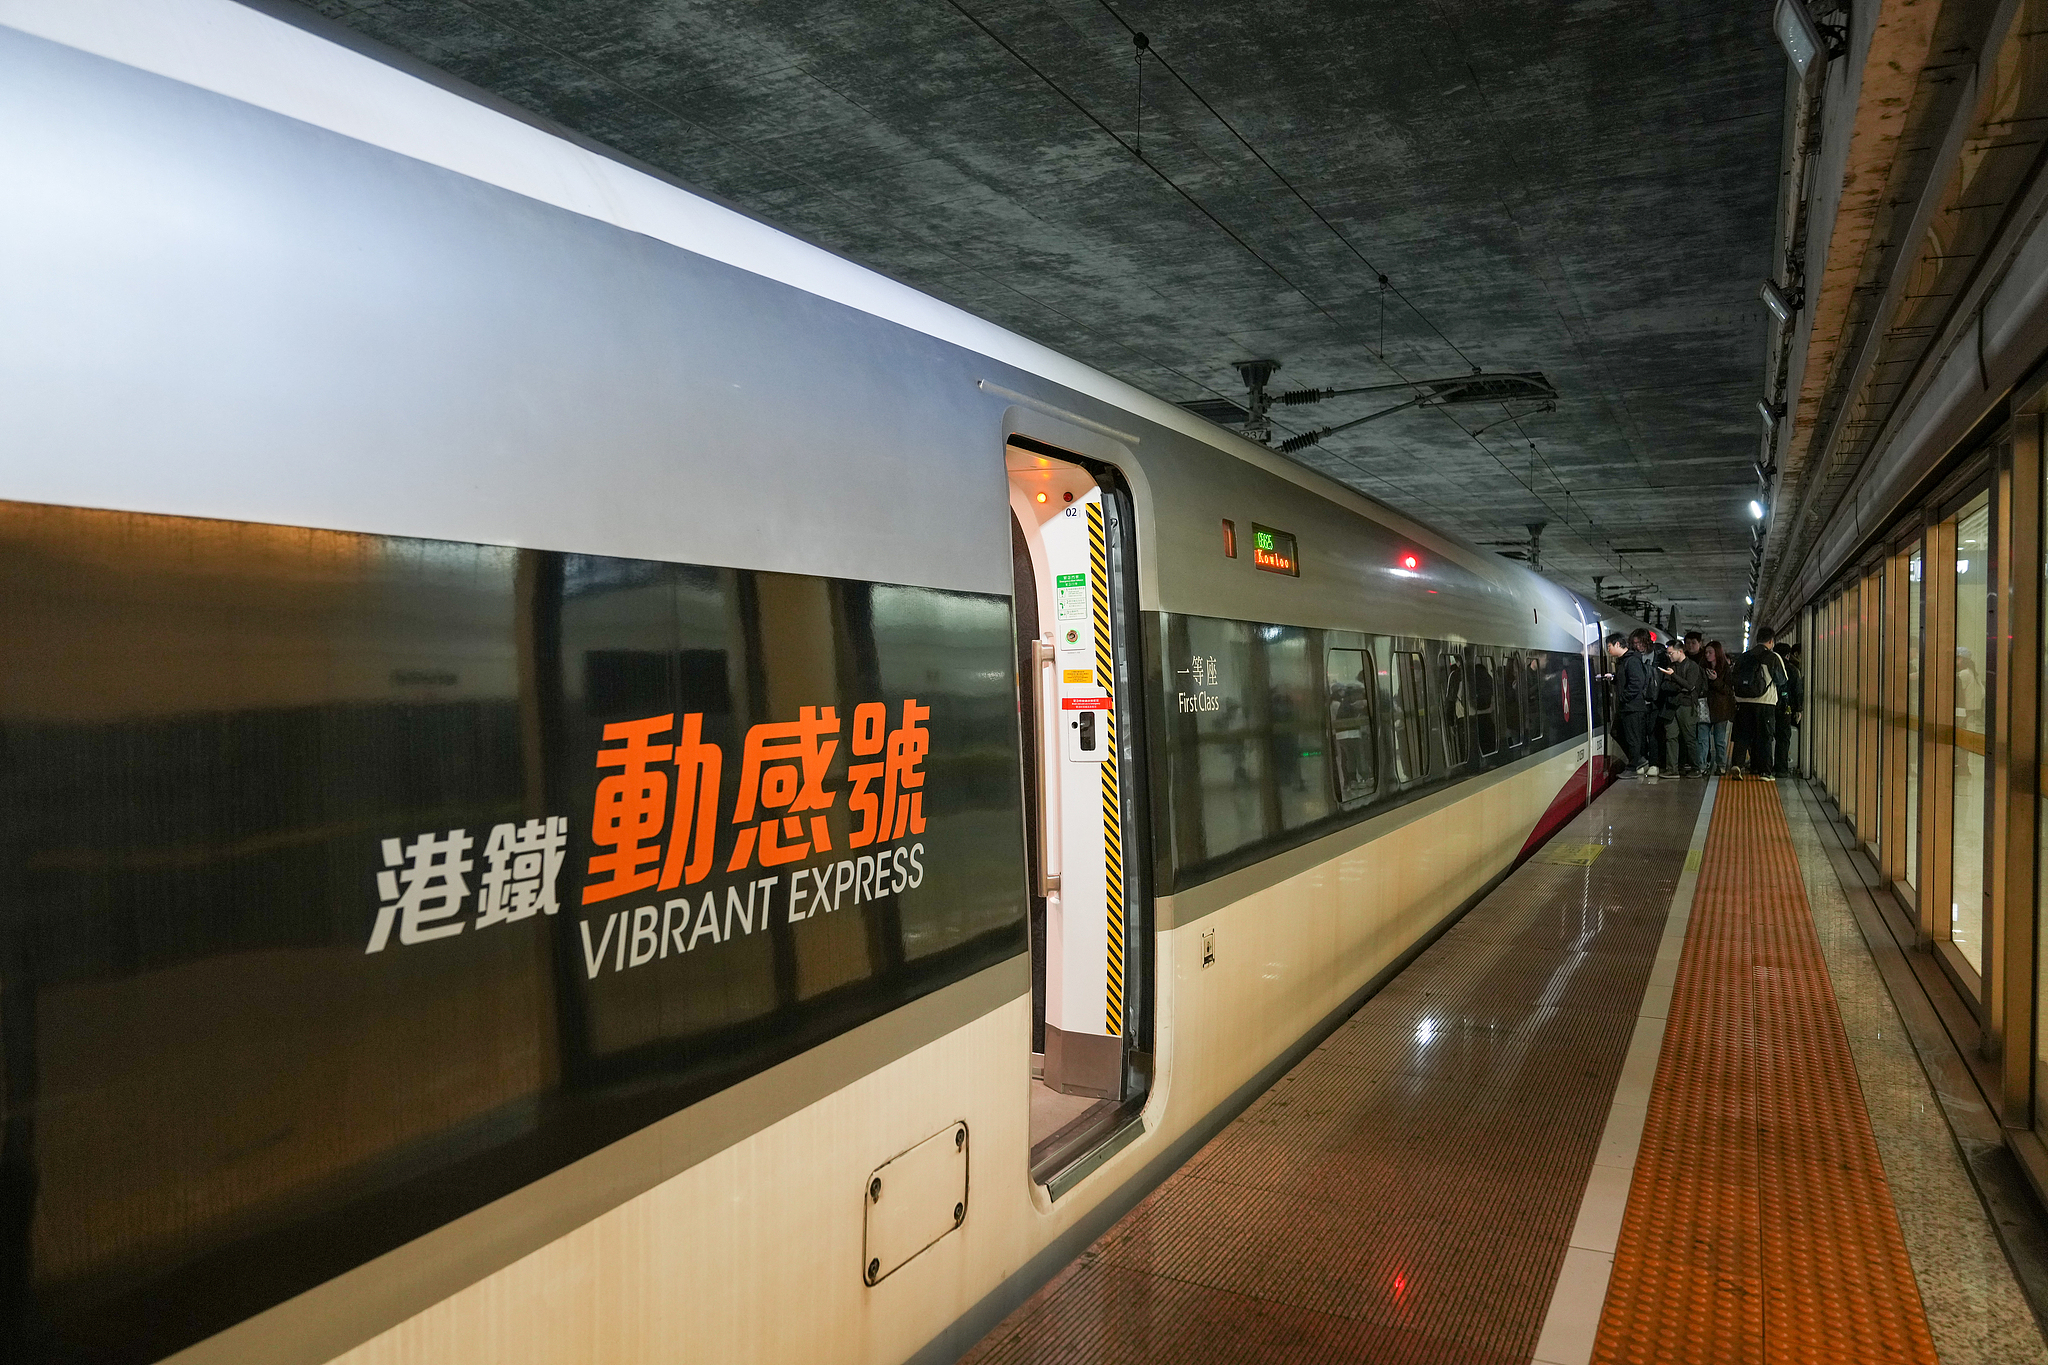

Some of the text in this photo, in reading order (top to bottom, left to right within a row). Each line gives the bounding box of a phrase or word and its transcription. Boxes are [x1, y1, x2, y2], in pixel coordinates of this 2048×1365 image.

[1065, 508, 1077, 517] 02
[1177, 656, 1218, 687] 一等座
[1178, 690, 1220, 714] First Class
[582, 698, 931, 906] 動感號
[365, 816, 568, 955] 港鐵
[579, 842, 926, 981] VIBRANT EXPRESS
